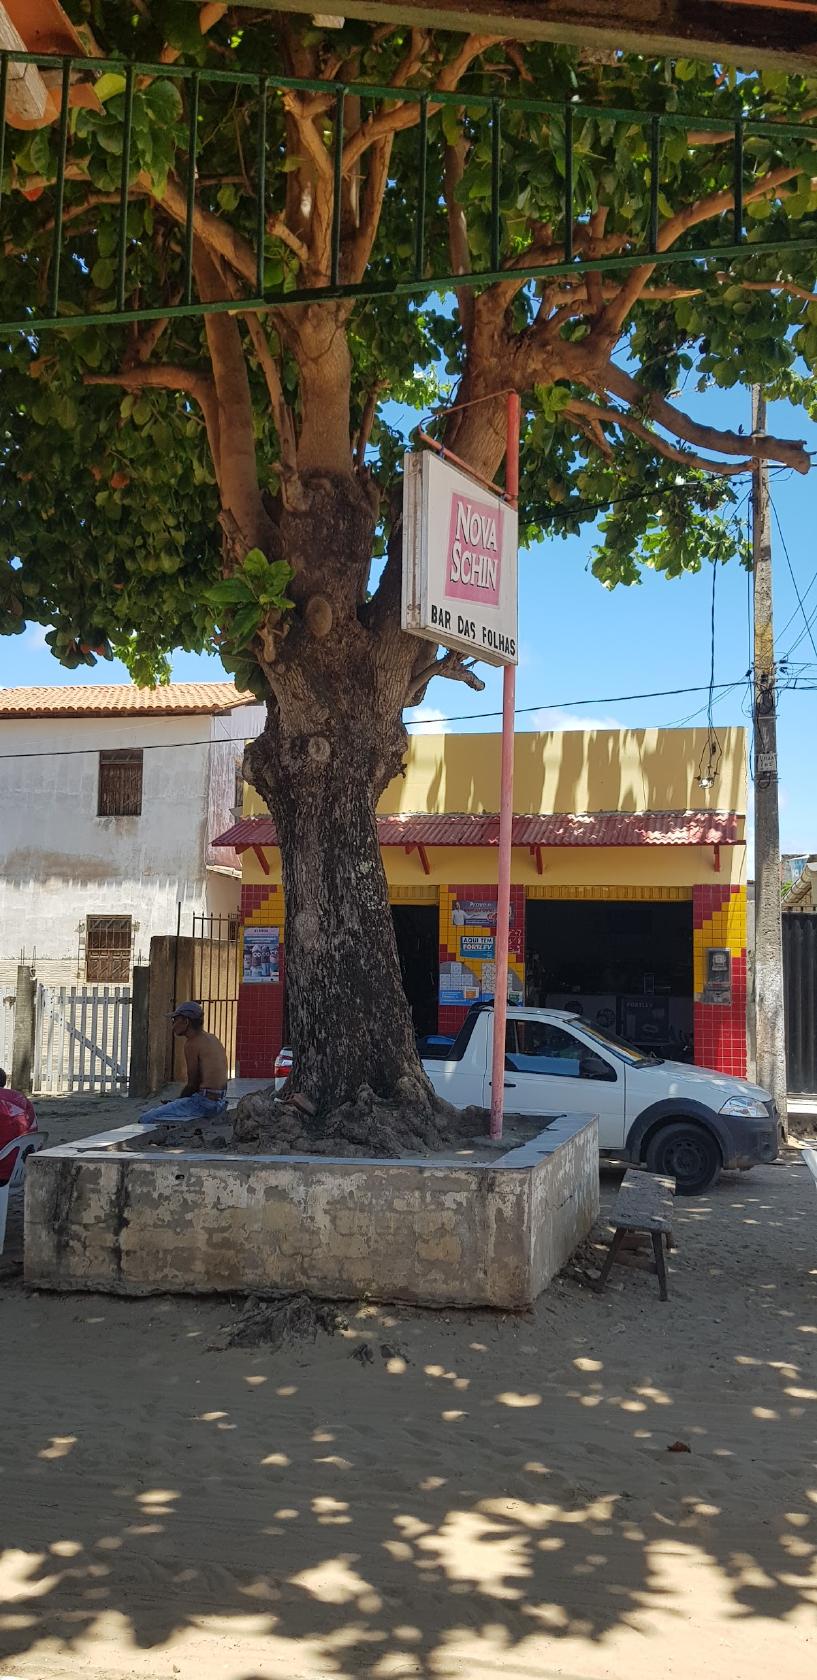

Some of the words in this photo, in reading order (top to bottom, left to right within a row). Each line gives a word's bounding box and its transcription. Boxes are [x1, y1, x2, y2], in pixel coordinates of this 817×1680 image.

[455, 500, 497, 552] NOVA
[449, 541, 499, 592] SCHIN
[431, 604, 451, 630] BAR
[457, 615, 476, 640] DAS
[482, 626, 516, 656] FOLHAS
